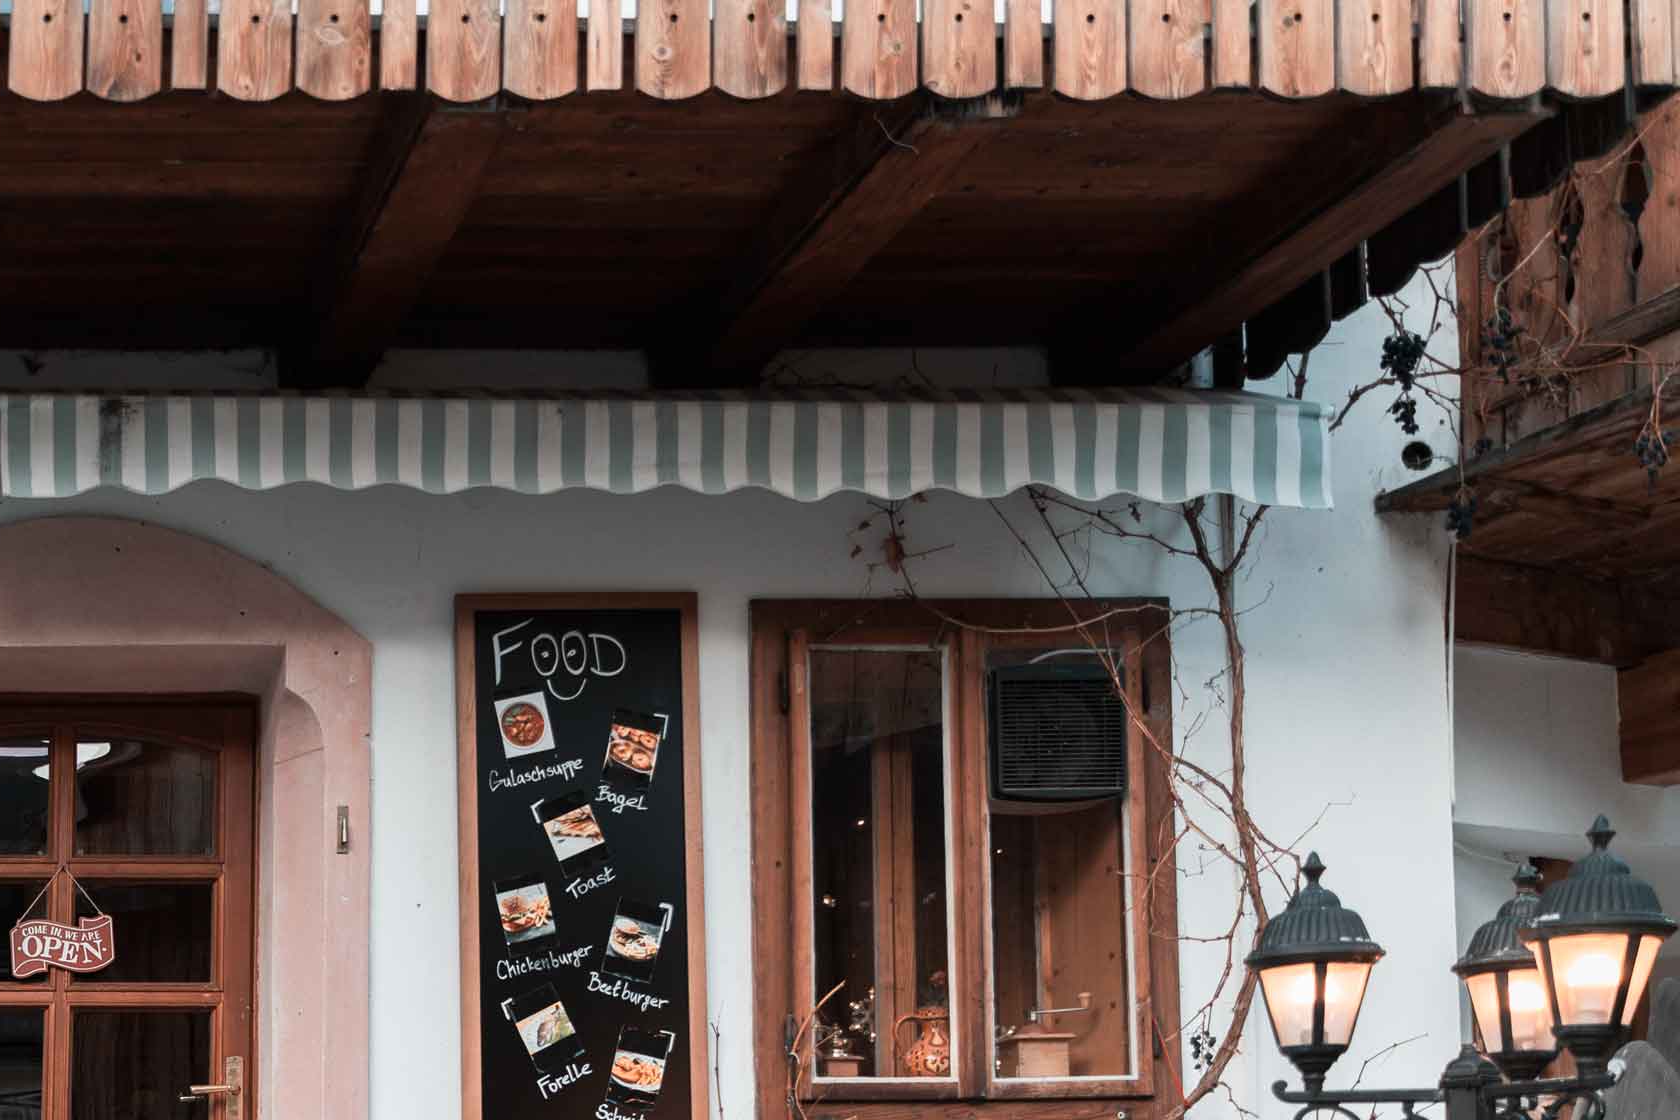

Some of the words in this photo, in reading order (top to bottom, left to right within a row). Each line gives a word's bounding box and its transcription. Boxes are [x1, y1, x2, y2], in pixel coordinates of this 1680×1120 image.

[492, 617, 626, 686] FOOD
[489, 757, 584, 792] Gulaschsuppe
[595, 785, 648, 814] Bagel
[565, 866, 617, 900] Toast
[22, 925, 48, 937] COME
[65, 930, 80, 941] WE
[81, 930, 101, 942] ARE
[22, 935, 103, 964] OPEN
[496, 945, 594, 981] Chickenburger
[537, 1062, 594, 1099] Forelle
